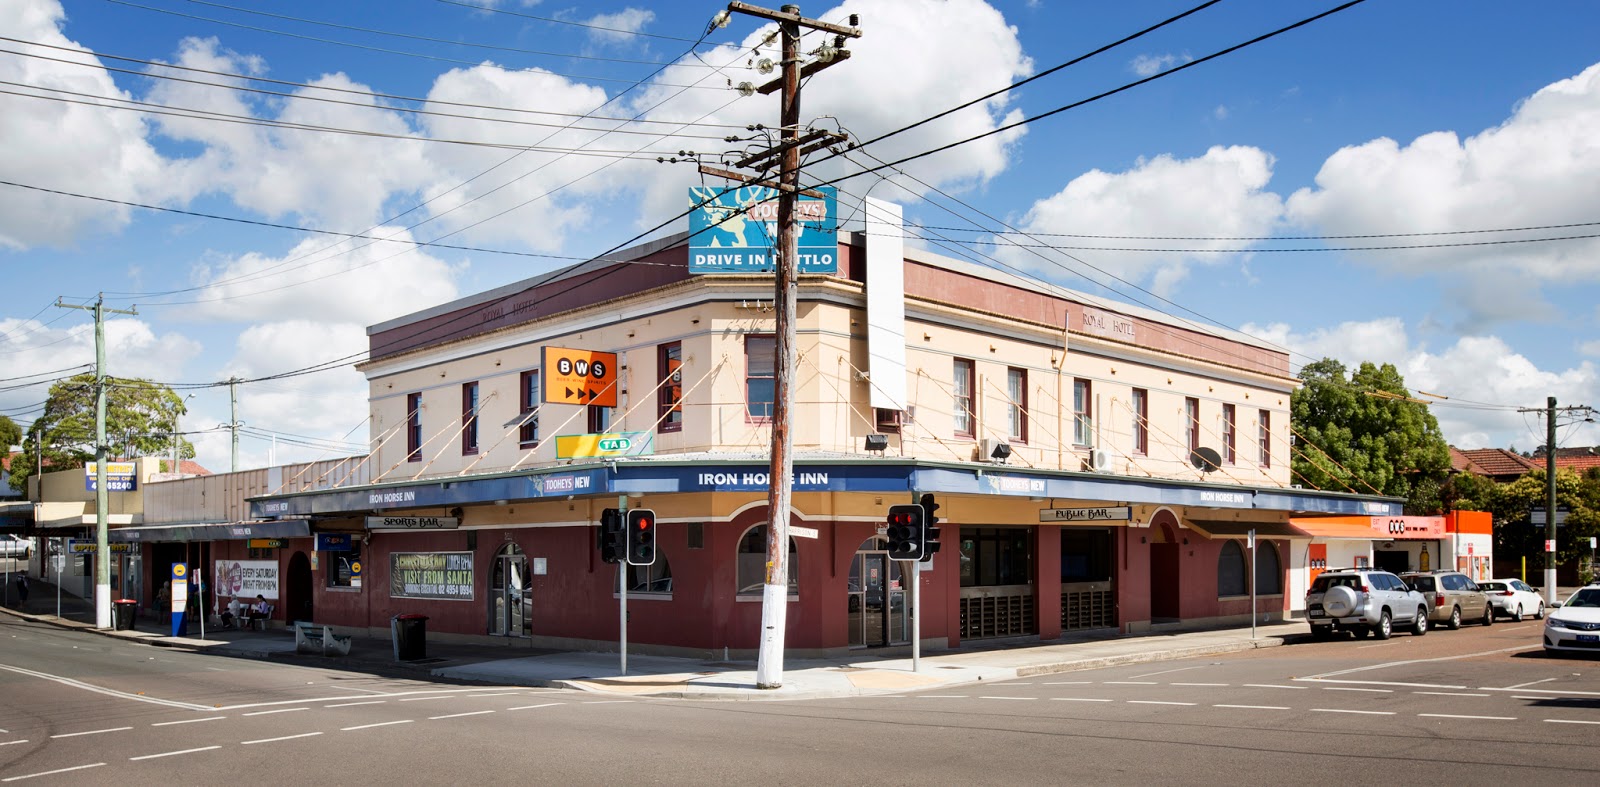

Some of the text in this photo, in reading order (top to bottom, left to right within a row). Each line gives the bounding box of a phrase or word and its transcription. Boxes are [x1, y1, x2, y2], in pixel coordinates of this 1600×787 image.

[754, 203, 820, 218] TOOEYS
[695, 254, 742, 266] DRIVE
[749, 254, 765, 266] IN
[482, 299, 538, 321] ROYAL HOTEL
[1082, 314, 1134, 336] ROYAL HOTEL
[560, 360, 604, 376] BWS
[603, 441, 628, 449] TAB
[546, 476, 590, 490] TOOHEYS NEW
[699, 474, 738, 485] IRON
[800, 472, 828, 485] INN
[91, 482, 131, 490] 465240
[1002, 479, 1045, 491] TOOHEYS NEW
[369, 491, 415, 504] IRON HORSE INN
[1200, 491, 1244, 502] IRON HORSE INN
[265, 502, 288, 512] TOOHEYS NEW
[1055, 509, 1112, 520] PUBLIC BAR
[419, 518, 443, 527] BAR
[1390, 521, 1405, 533] BWS
[400, 554, 434, 570] CHRISTMAS
[243, 568, 255, 578] EVERY
[255, 568, 277, 579] SATURDAY
[404, 570, 472, 584] VISIT FROM SANTA
[243, 580, 255, 589] NIGHT
[255, 580, 266, 590] FROM
[438, 585, 445, 595] 02
[446, 585, 458, 595] 4954
